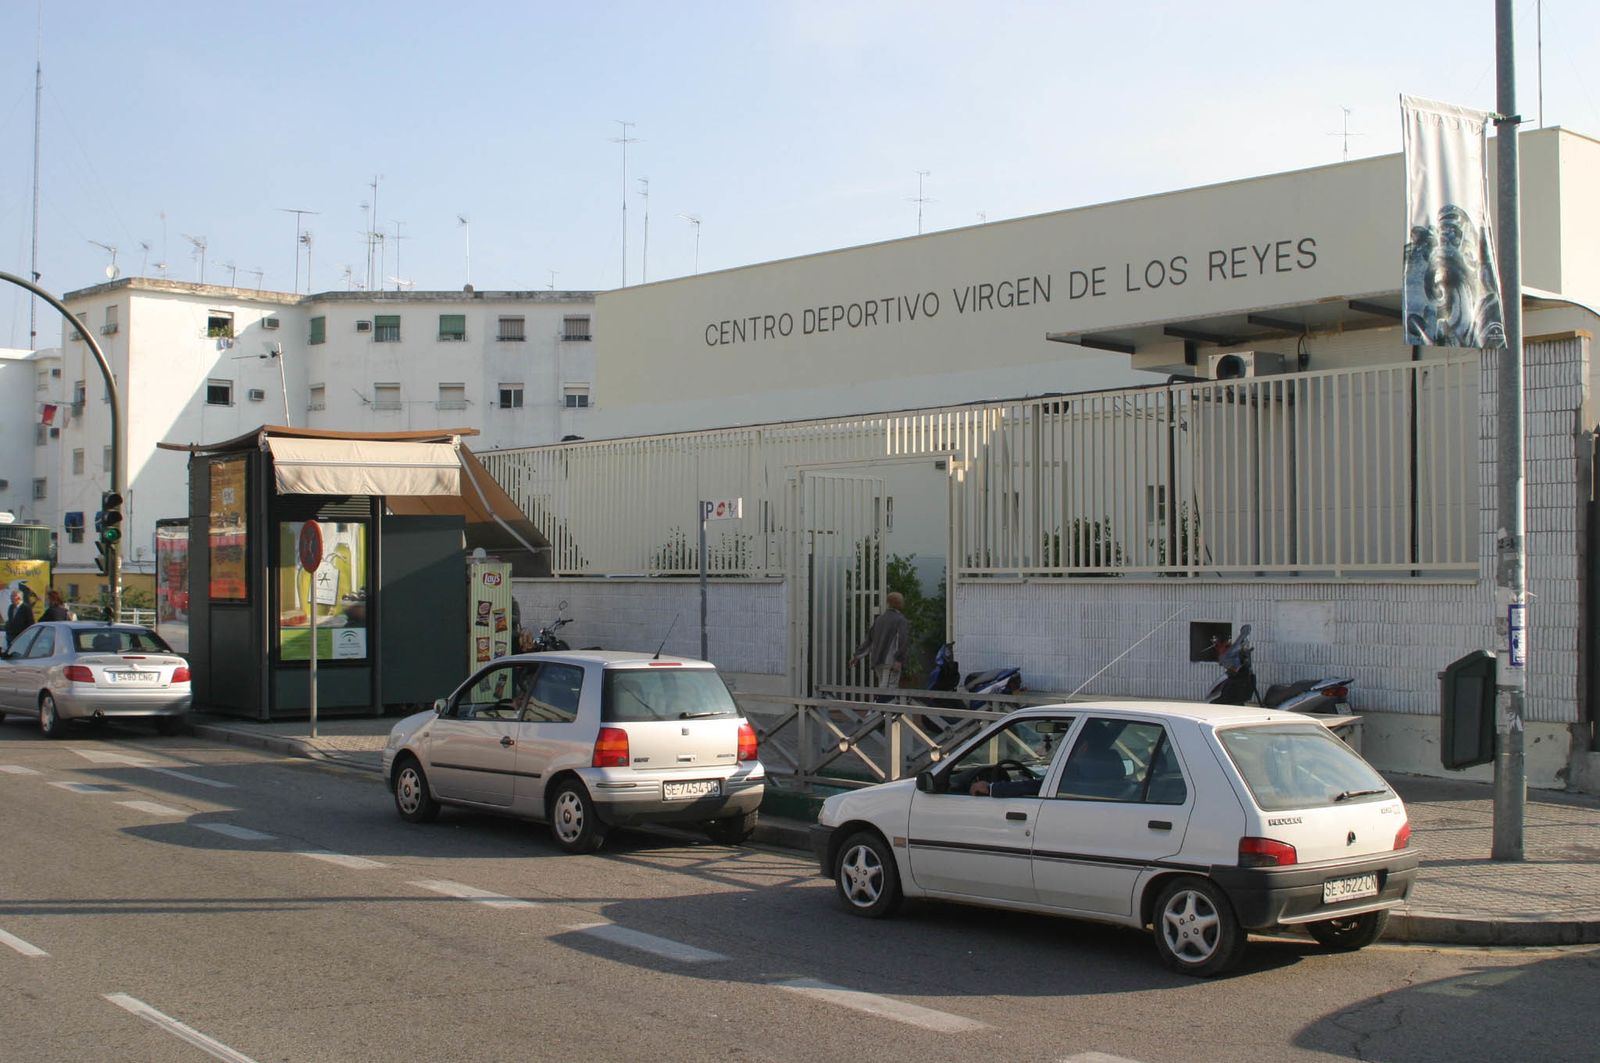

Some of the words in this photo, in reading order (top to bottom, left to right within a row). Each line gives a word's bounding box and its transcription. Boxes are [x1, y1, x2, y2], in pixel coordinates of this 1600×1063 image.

[705, 312, 793, 347] CENTRO
[802, 291, 940, 335] DEPORTIVO
[952, 274, 1051, 314] VIRGEN
[1069, 266, 1107, 300] DE
[1126, 255, 1188, 293] LOS
[1208, 237, 1317, 281] REYES
